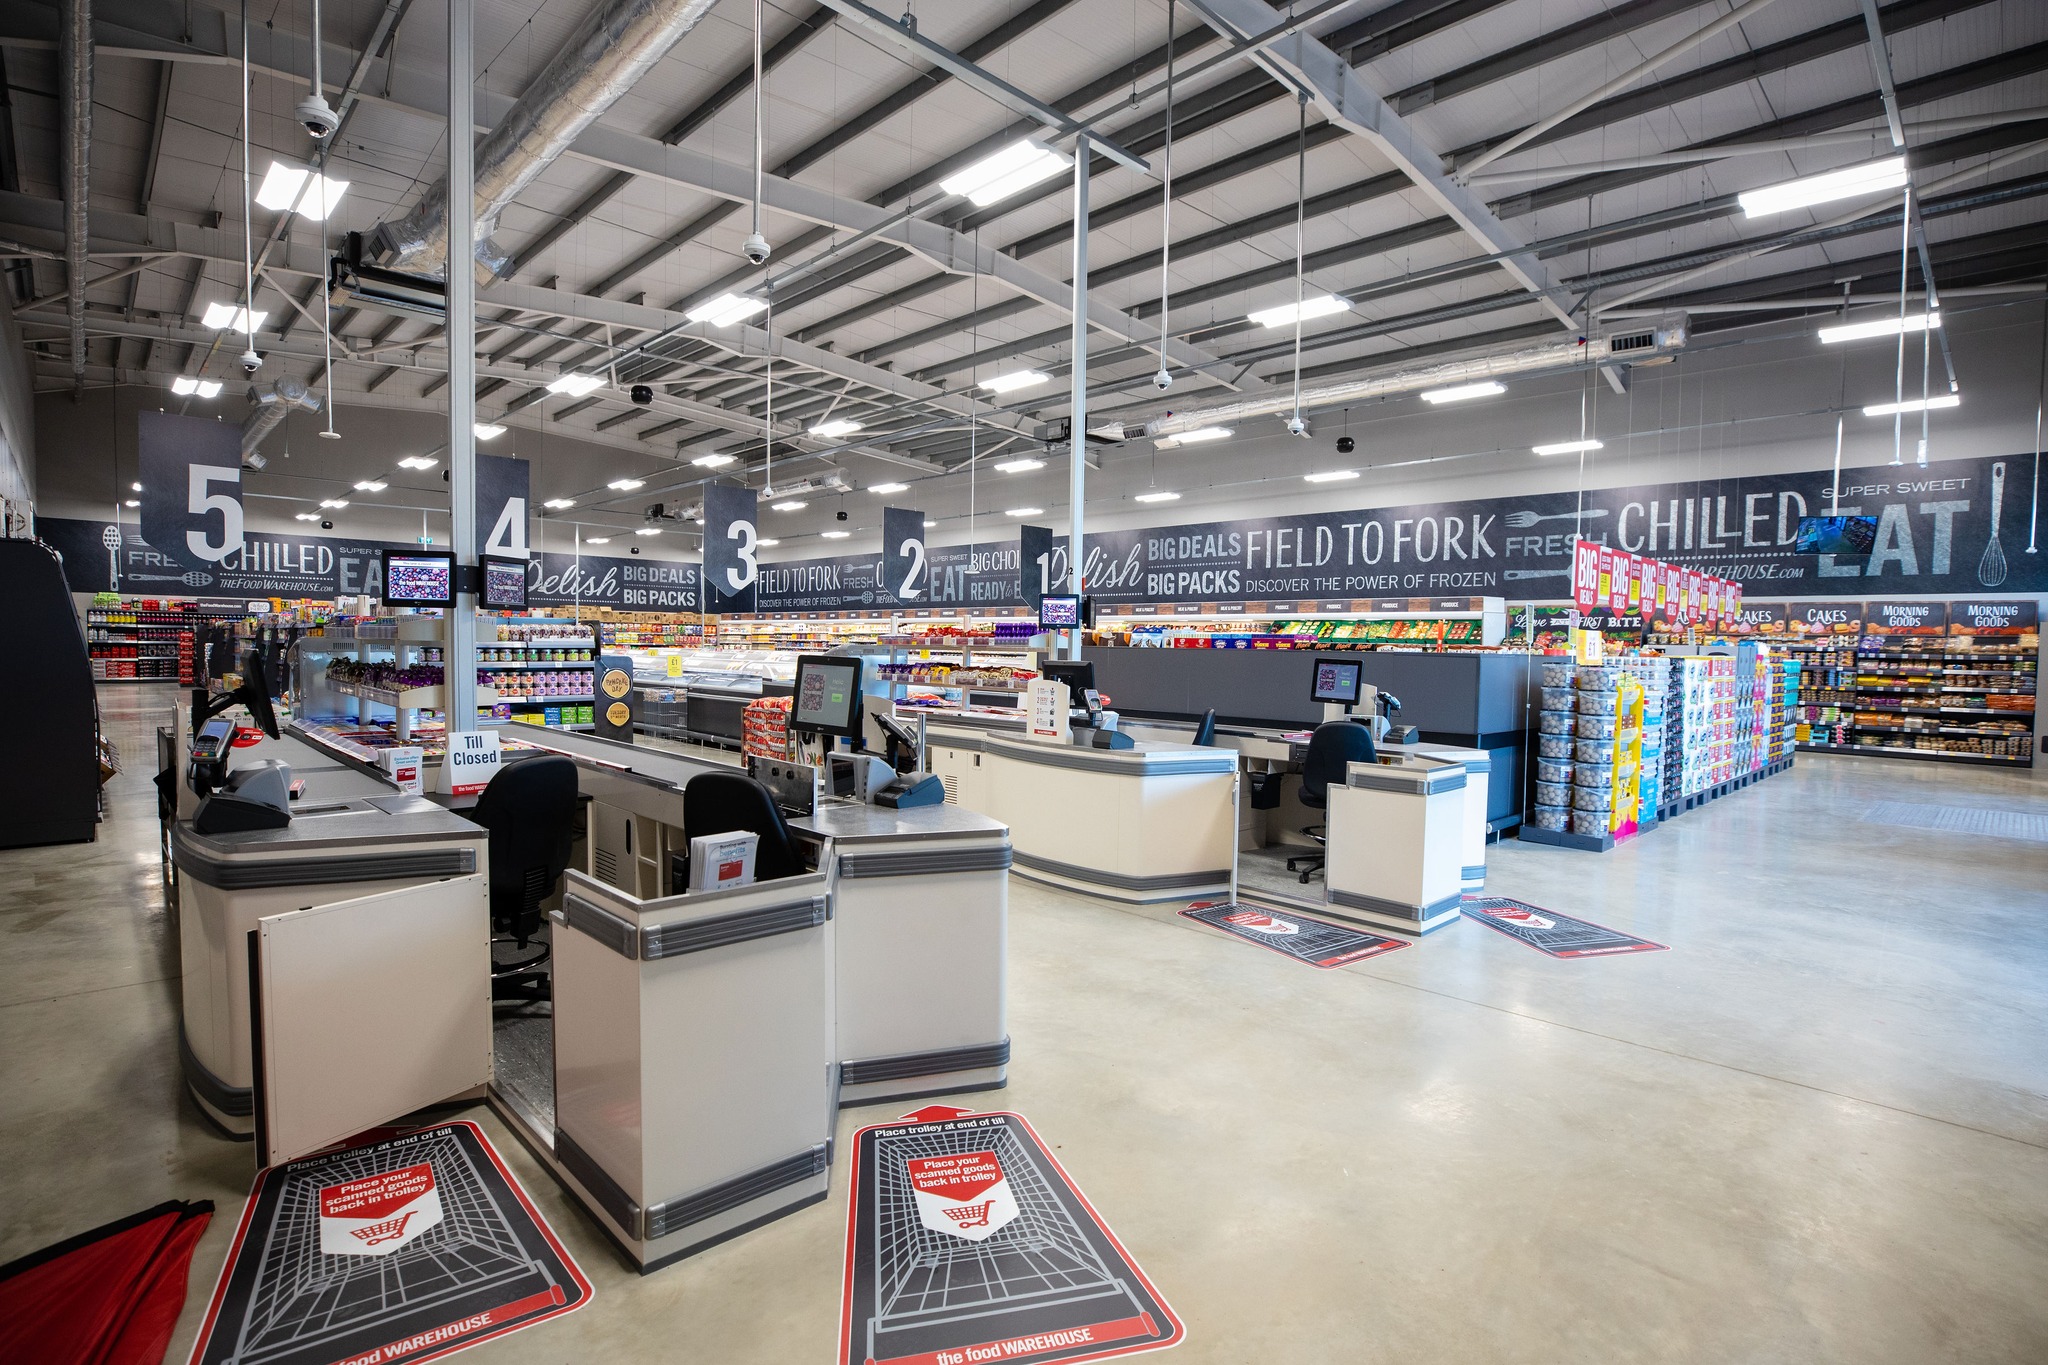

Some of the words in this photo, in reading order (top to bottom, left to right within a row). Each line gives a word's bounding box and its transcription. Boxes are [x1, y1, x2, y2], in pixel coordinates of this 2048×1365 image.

[1821, 484, 1890, 498] SUPER
[1896, 478, 1971, 494] SWEET
[186, 464, 244, 562] 5
[1618, 491, 1808, 552] CHILLED
[486, 497, 530, 558] 4
[1148, 538, 1176, 561] BIG
[1179, 532, 1241, 558] DEALS
[1246, 526, 1334, 570] FIELD
[1342, 520, 1384, 566] TO
[1394, 514, 1496, 563] FORK
[128, 552, 184, 567] FRE
[726, 520, 757, 590] 3
[950, 554, 968, 562] SWEET
[972, 552, 990, 571] BIG
[992, 550, 1020, 570] CHOI
[340, 558, 382, 593] EA
[624, 566, 646, 582] BIG
[650, 568, 696, 584] DEALS
[899, 538, 924, 598] 2
[1036, 552, 1048, 594] 1
[1051, 544, 1144, 590] Dlish
[1578, 547, 1597, 590] BIG
[1612, 556, 1629, 594] BIG
[528, 560, 620, 598] Delish
[759, 570, 790, 594] FIELD
[792, 568, 804, 592] TO
[808, 565, 841, 592] FORK
[844, 576, 874, 589] FRESH
[930, 564, 974, 602] EAT
[970, 581, 1005, 600] READY
[1148, 574, 1174, 595] BIG
[1178, 570, 1241, 594] PACKS
[1246, 578, 1310, 593] DISCOVER
[1314, 577, 1341, 591] THE
[1346, 575, 1398, 590] POWER
[1404, 574, 1424, 588] OF
[1430, 572, 1496, 588] FROZEN
[1641, 564, 1656, 599] BIG
[1667, 570, 1680, 603] BIG
[624, 589, 646, 605] BIG
[650, 590, 696, 607] PACKS
[795, 598, 813, 607] POWER
[820, 597, 842, 606] FROZEN
[1580, 590, 1594, 605] DEALS
[1514, 614, 1547, 628] Lve
[1608, 617, 1641, 627] BITE
[1737, 609, 1772, 624] CAKES
[1807, 608, 1847, 624] CAKES
[1883, 605, 1929, 616] MORNING
[1889, 615, 1921, 627] GOODS
[1968, 604, 2018, 616] MORNING
[1975, 615, 2009, 627] GOODS
[464, 736, 482, 749] Till
[454, 750, 496, 765] Closed
[874, 1127, 906, 1138] Place
[908, 1123, 942, 1136] trolley
[945, 1121, 955, 1131] at
[957, 1119, 977, 1129] end
[979, 1118, 991, 1127] of
[991, 1116, 1005, 1125] till
[286, 1156, 329, 1172] Place
[332, 1145, 375, 1163] trolley
[377, 1142, 391, 1152] at
[393, 1137, 418, 1148] end
[420, 1132, 434, 1142] of
[436, 1127, 452, 1138] till
[914, 1167, 961, 1179] scanned
[962, 1162, 996, 1175] goods
[924, 1159, 955, 1169] Place
[957, 1156, 980, 1166] your
[325, 1187, 384, 1207] scanned
[387, 1174, 428, 1192] goods
[340, 1180, 380, 1194] Place
[382, 1170, 412, 1186] your
[919, 1177, 947, 1188] back
[949, 1175, 959, 1184] in
[960, 1171, 996, 1183] trolley
[329, 1199, 365, 1214] back
[368, 1196, 380, 1207] in
[383, 1184, 426, 1204] trolley
[384, 1313, 492, 1354] WAREHOUSE
[937, 1352, 962, 1365] the
[965, 1345, 1000, 1362] food
[1002, 1328, 1094, 1356] WAREHOUSE
